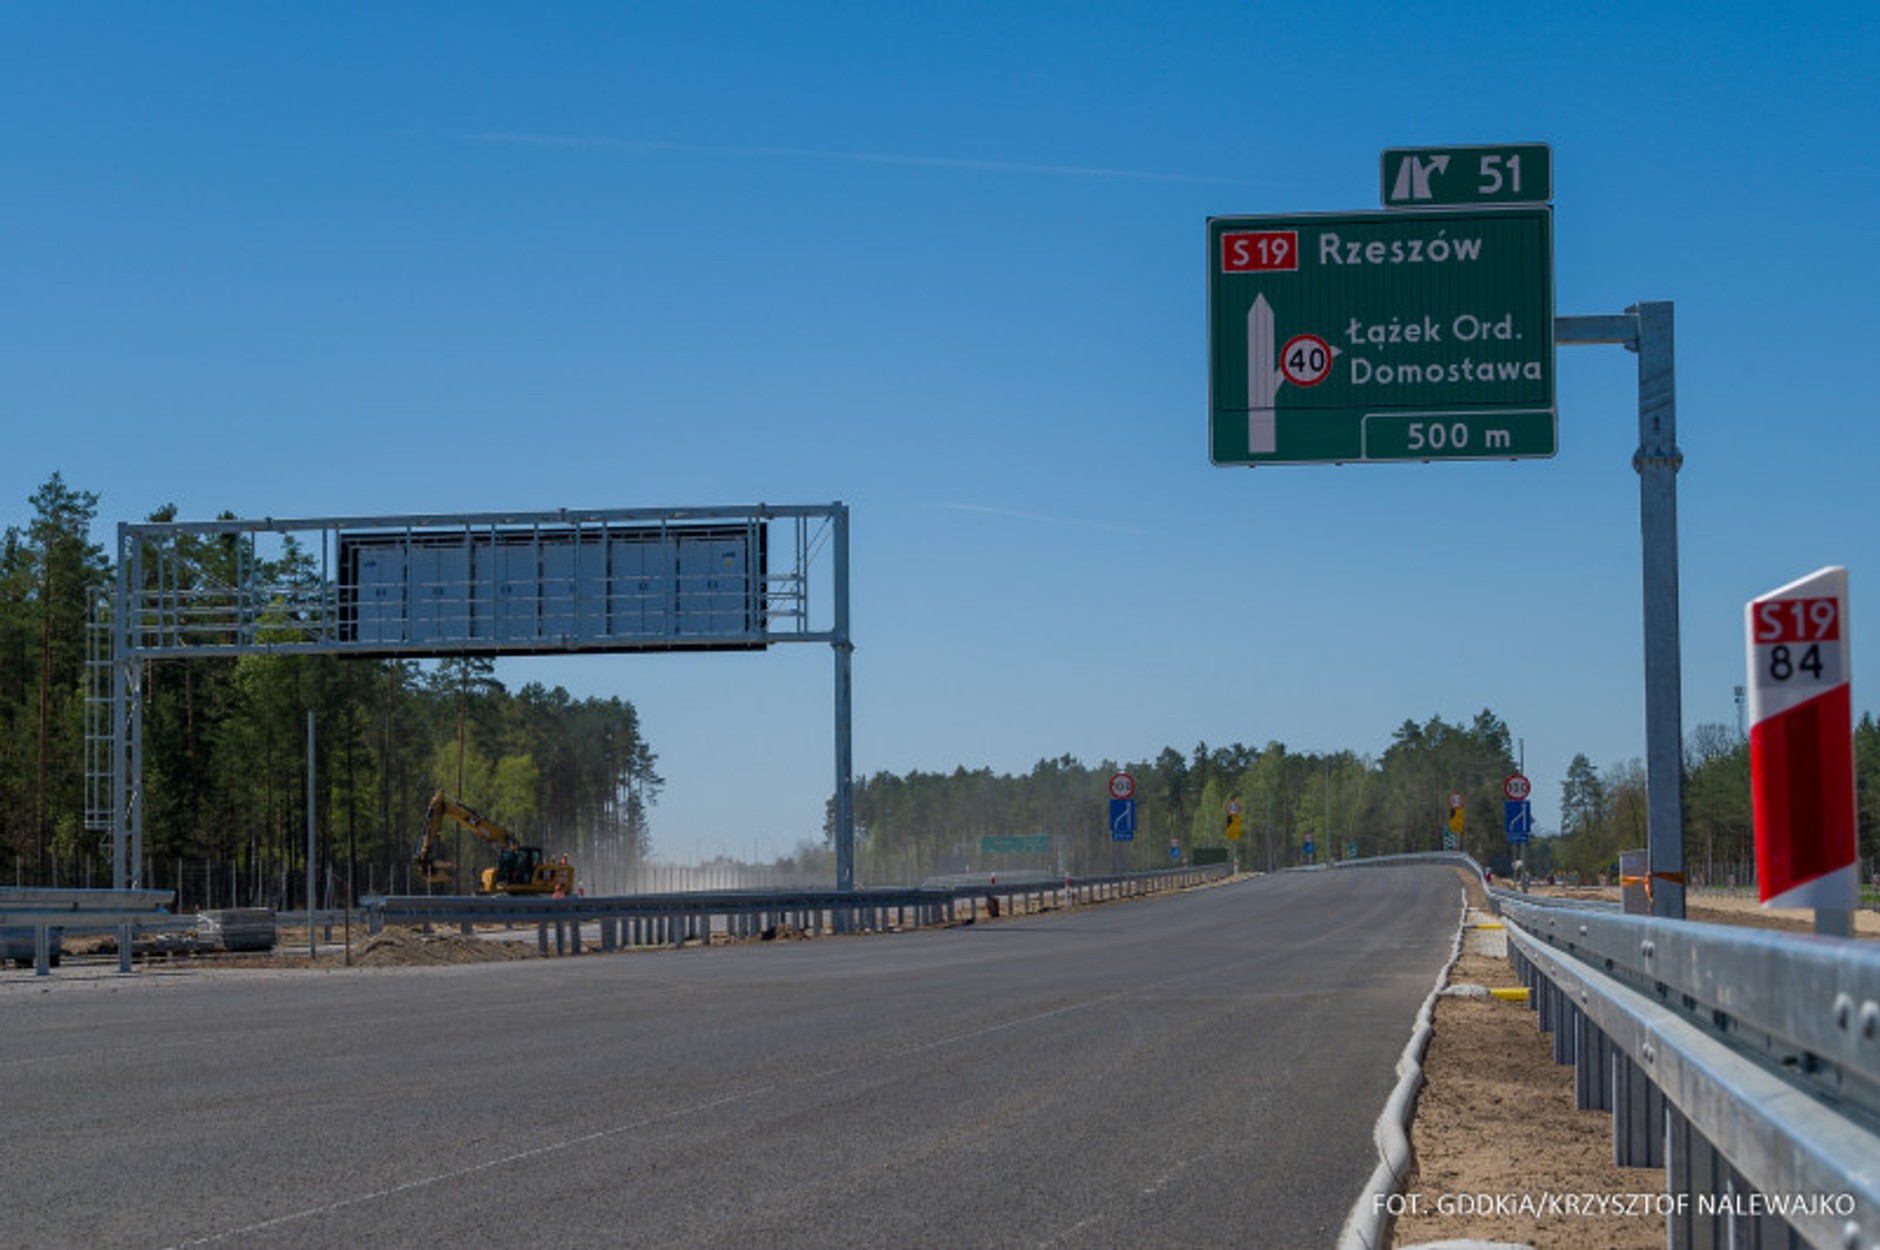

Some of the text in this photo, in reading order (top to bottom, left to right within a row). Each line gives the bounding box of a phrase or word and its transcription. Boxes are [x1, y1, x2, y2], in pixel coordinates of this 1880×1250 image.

[1478, 154, 1521, 193] 51
[1320, 230, 1482, 264] Rzeszów
[1345, 313, 1522, 351] Łążek Ord.
[1288, 347, 1326, 372] 40
[1351, 358, 1542, 384] Domostawa
[1408, 423, 1510, 450] 500 m
[1770, 644, 1823, 681] 84
